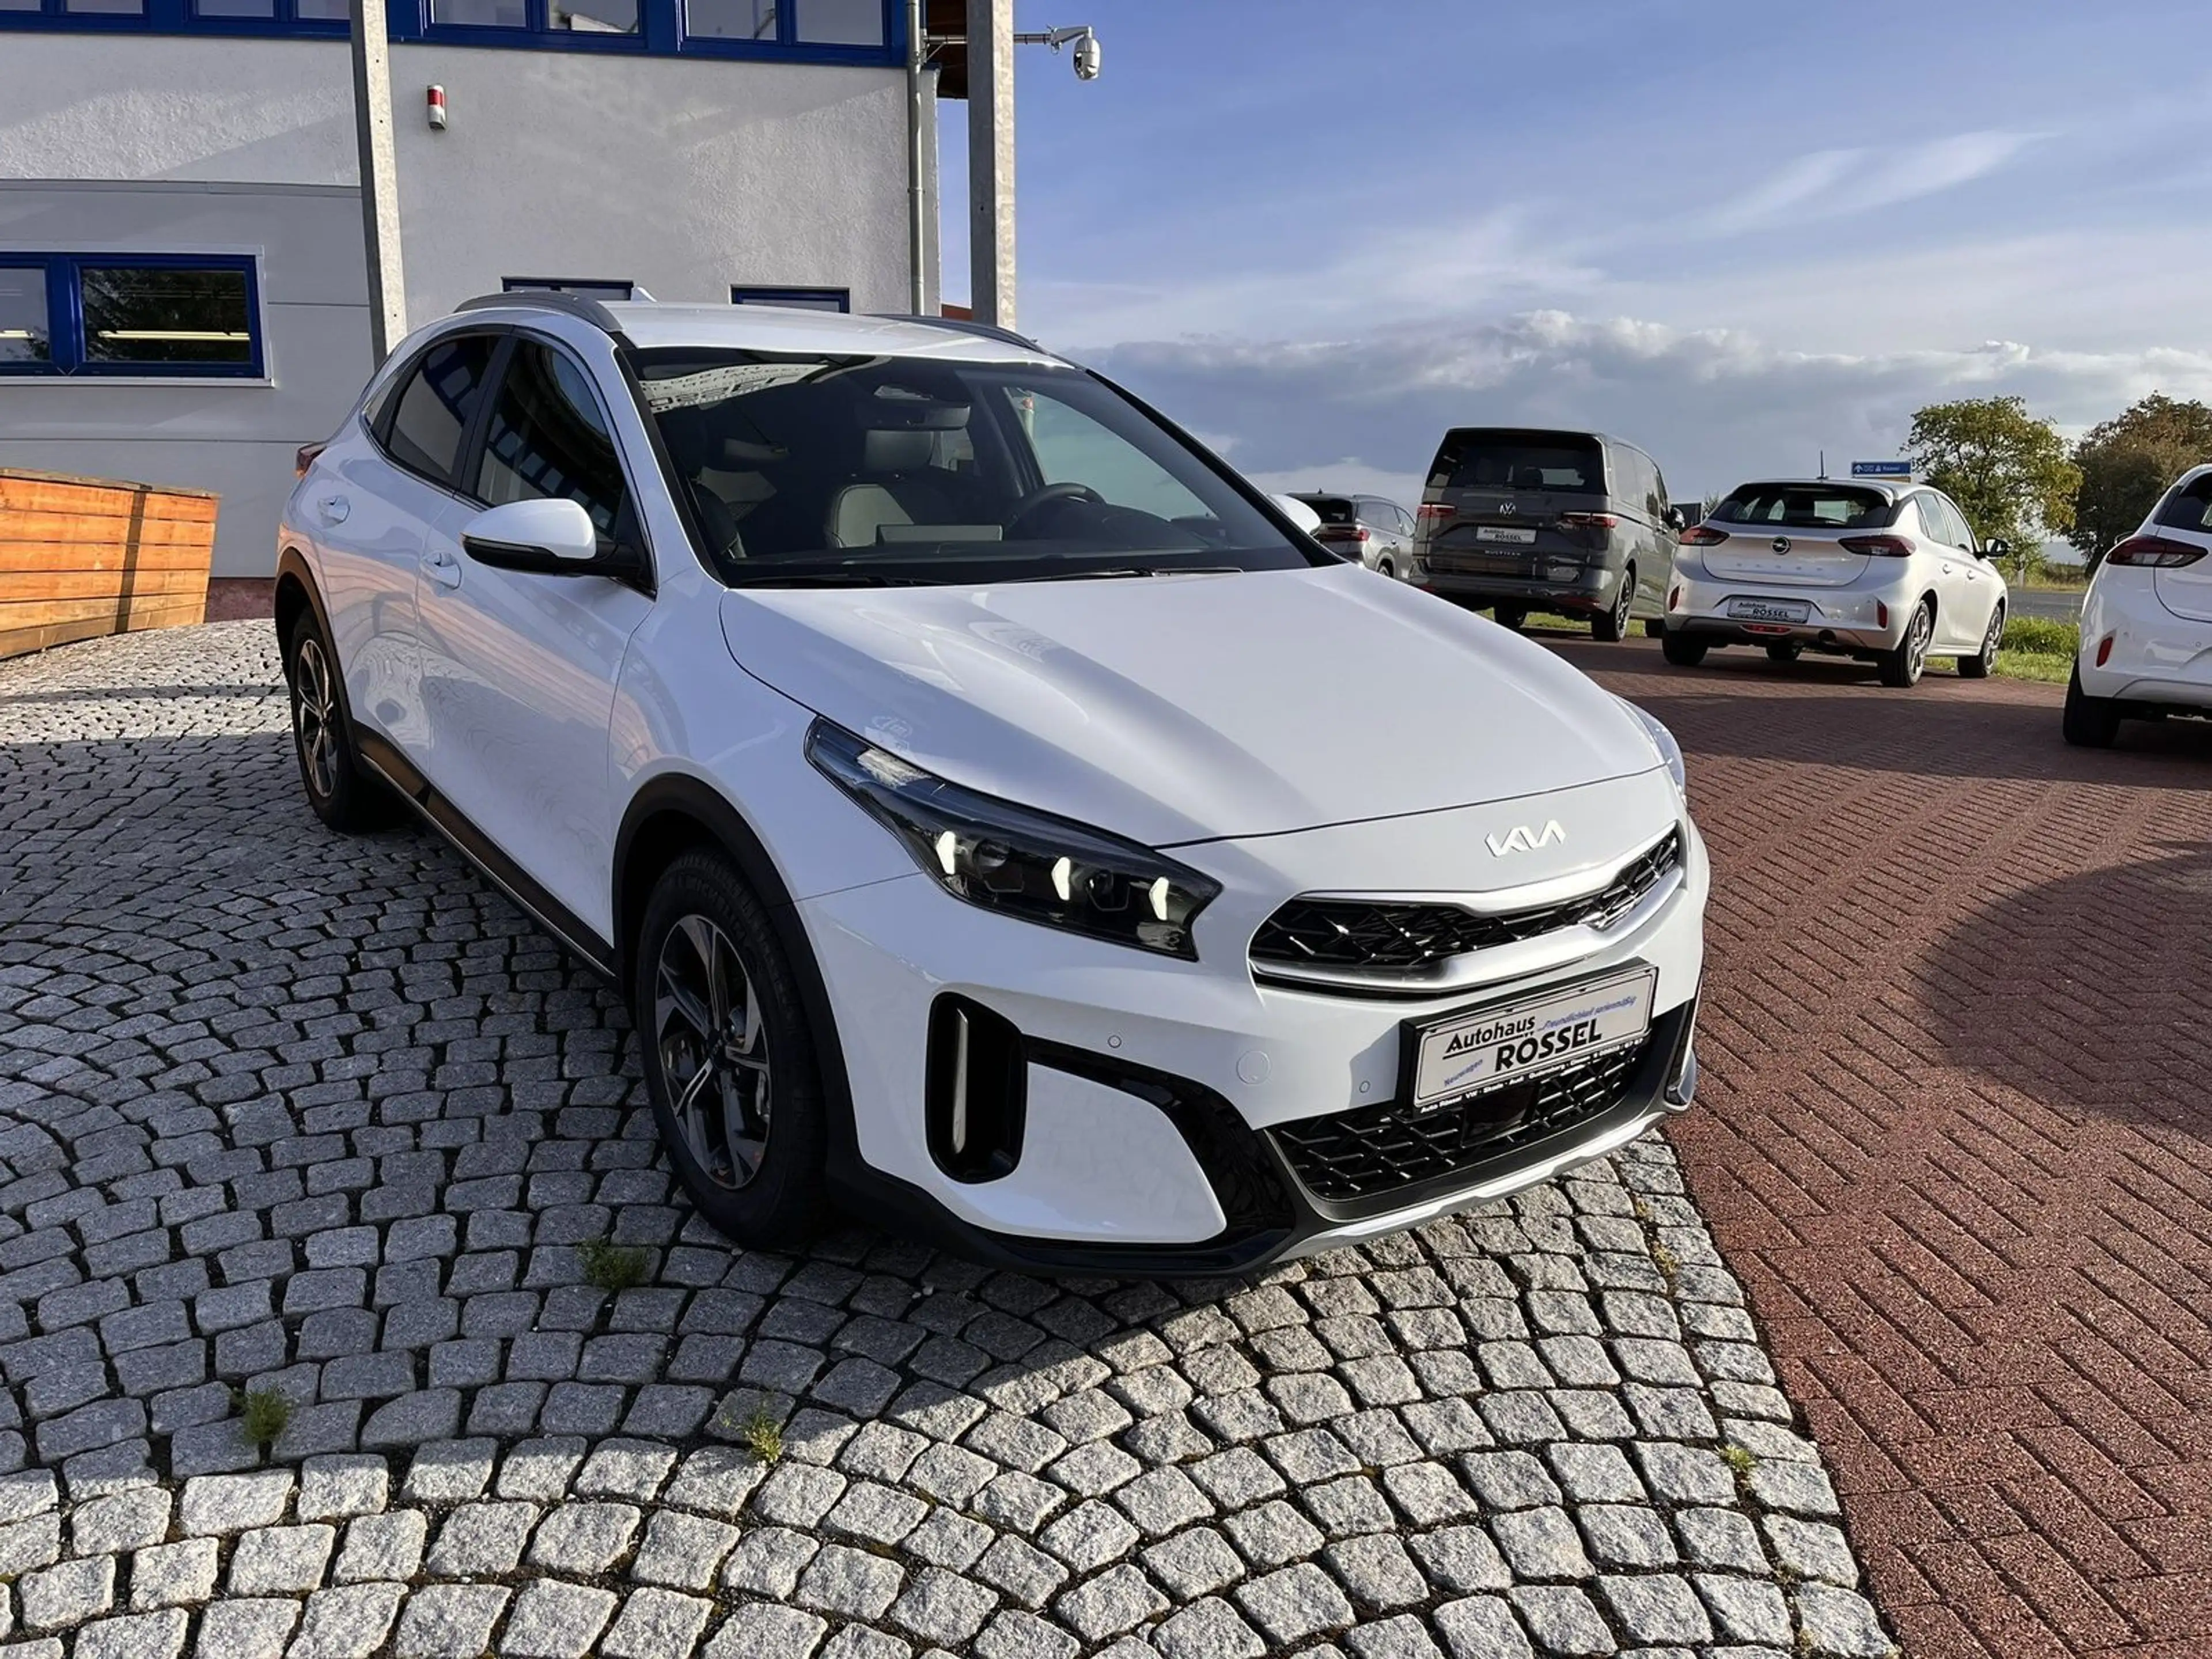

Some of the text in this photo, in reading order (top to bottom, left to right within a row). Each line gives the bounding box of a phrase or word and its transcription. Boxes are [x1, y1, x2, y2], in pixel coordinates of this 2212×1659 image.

[1752, 608, 1789, 618] RÖSSEL
[1483, 819, 1566, 858] KIA
[1446, 1016, 1536, 1054] Autohaus
[1494, 1018, 1603, 1072] RÖSSEL
